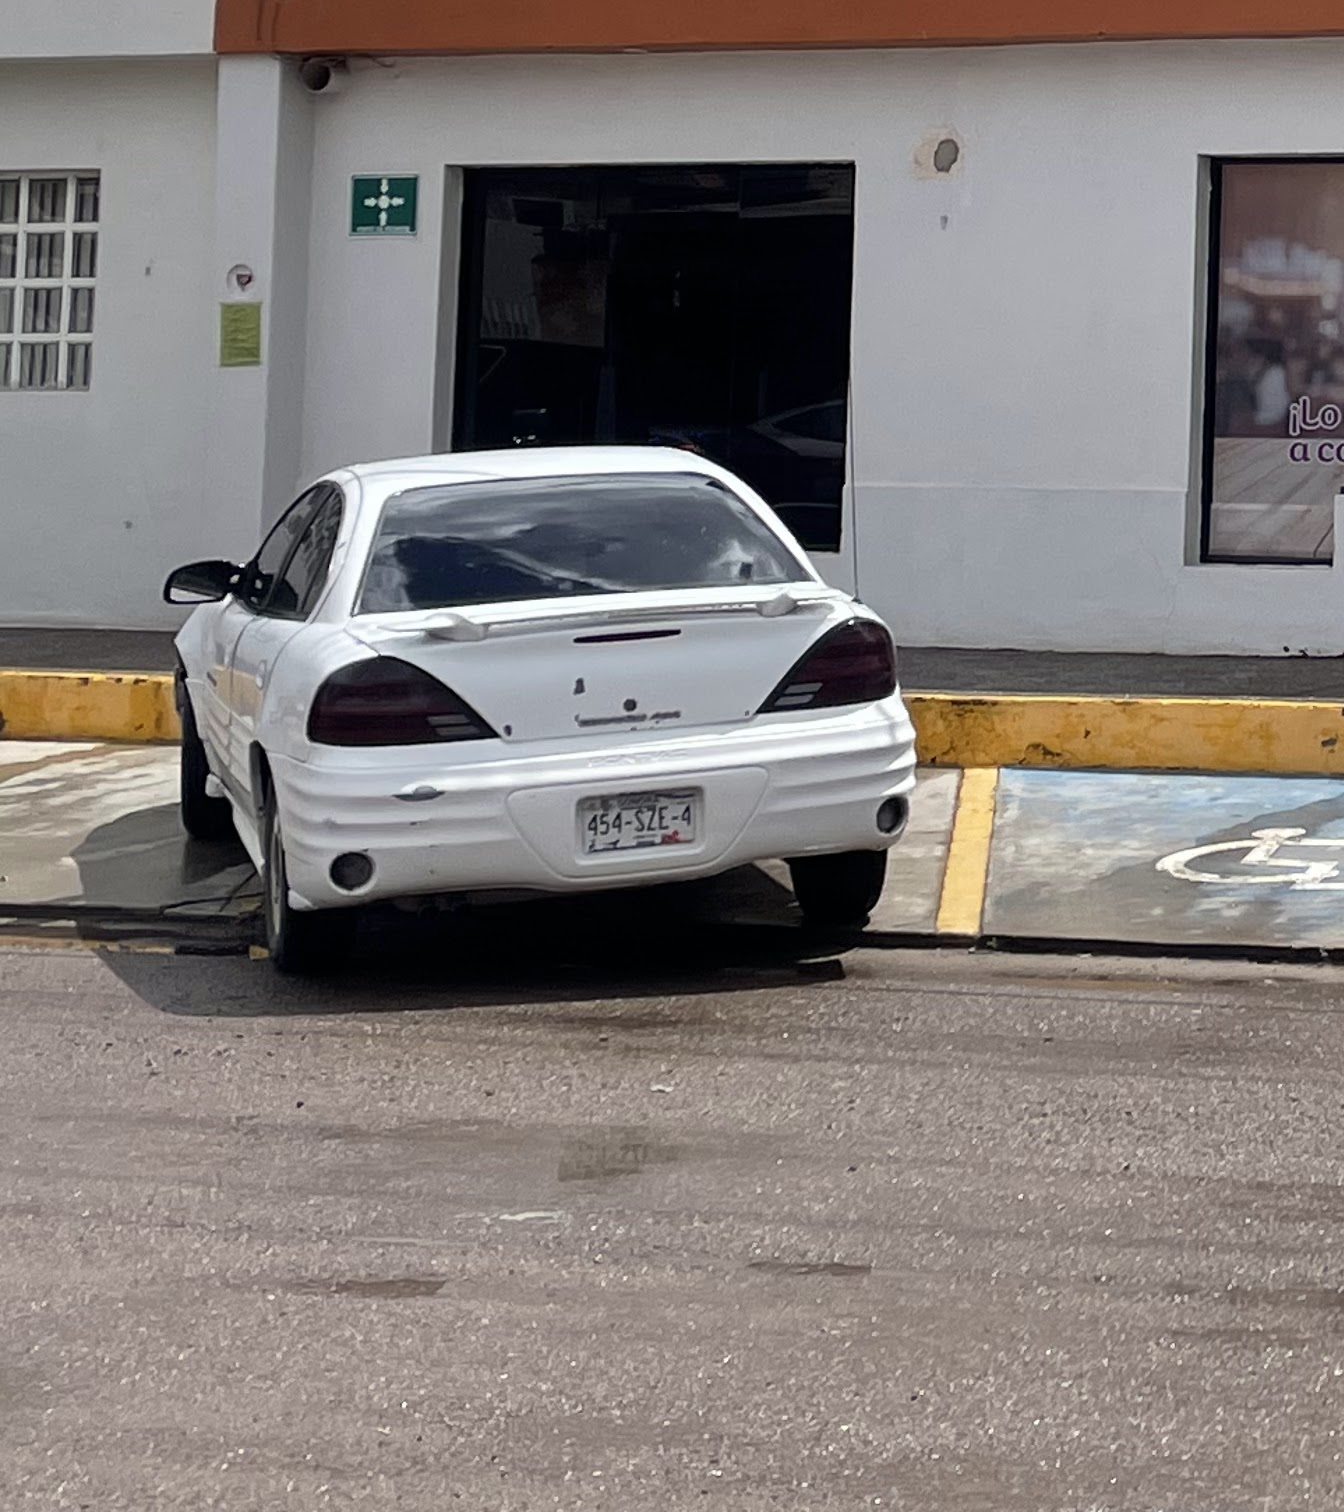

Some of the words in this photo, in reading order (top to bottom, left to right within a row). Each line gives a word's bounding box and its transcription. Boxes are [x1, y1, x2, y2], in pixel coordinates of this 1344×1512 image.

[1290, 397, 1340, 434] ¡Lo
[1290, 441, 1310, 463] a
[587, 803, 692, 837] 454-SZE-4
